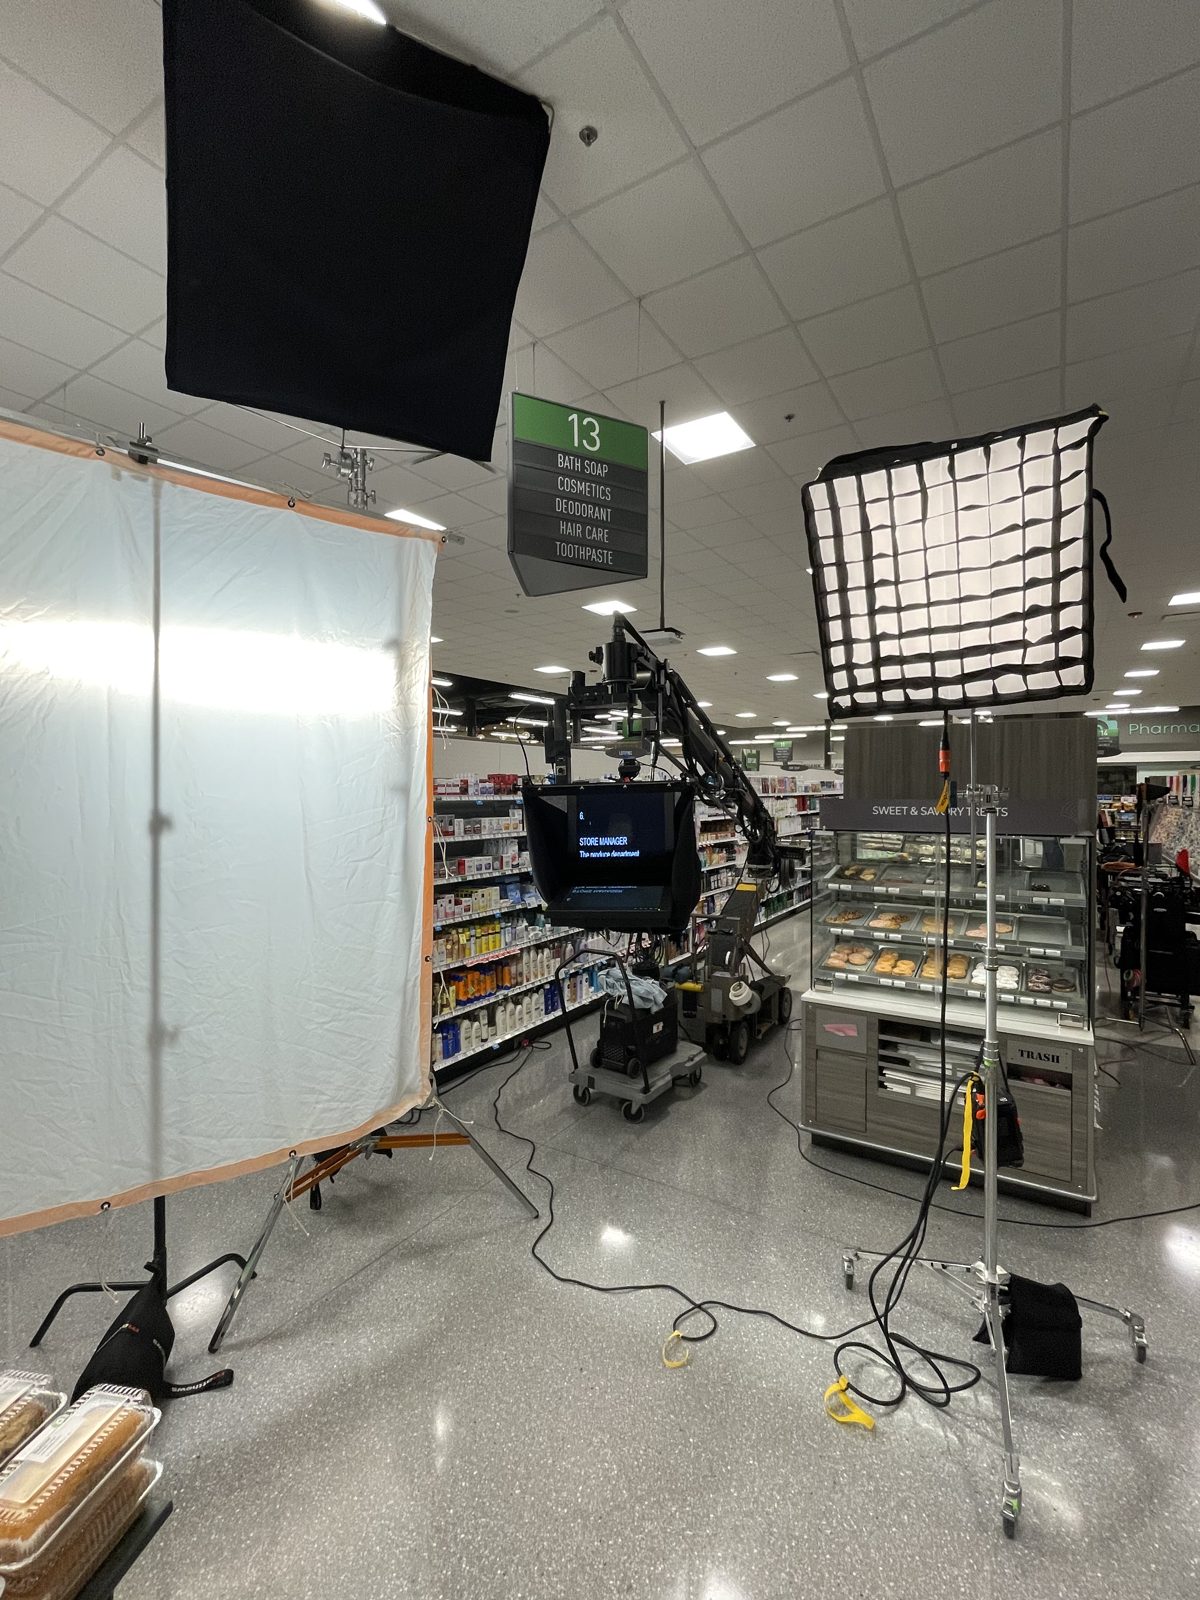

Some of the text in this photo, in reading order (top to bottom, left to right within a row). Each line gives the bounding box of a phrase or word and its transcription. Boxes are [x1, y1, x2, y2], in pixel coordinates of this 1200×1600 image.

[567, 413, 601, 452] 13
[557, 453, 609, 478] BATH SOAP
[557, 476, 612, 501] COSMETICS
[555, 497, 612, 523] DEODORANT
[559, 521, 609, 543] HAIR CARE
[555, 541, 613, 565] TOOTHPASTE
[1129, 722, 1200, 735] Pharma
[872, 805, 907, 816] SWEET
[910, 806, 918, 816] &
[966, 807, 1009, 817] TRETS
[579, 836, 628, 846] STORE MANAGER
[579, 850, 590, 858] The
[1017, 1048, 1060, 1064] TRASH
